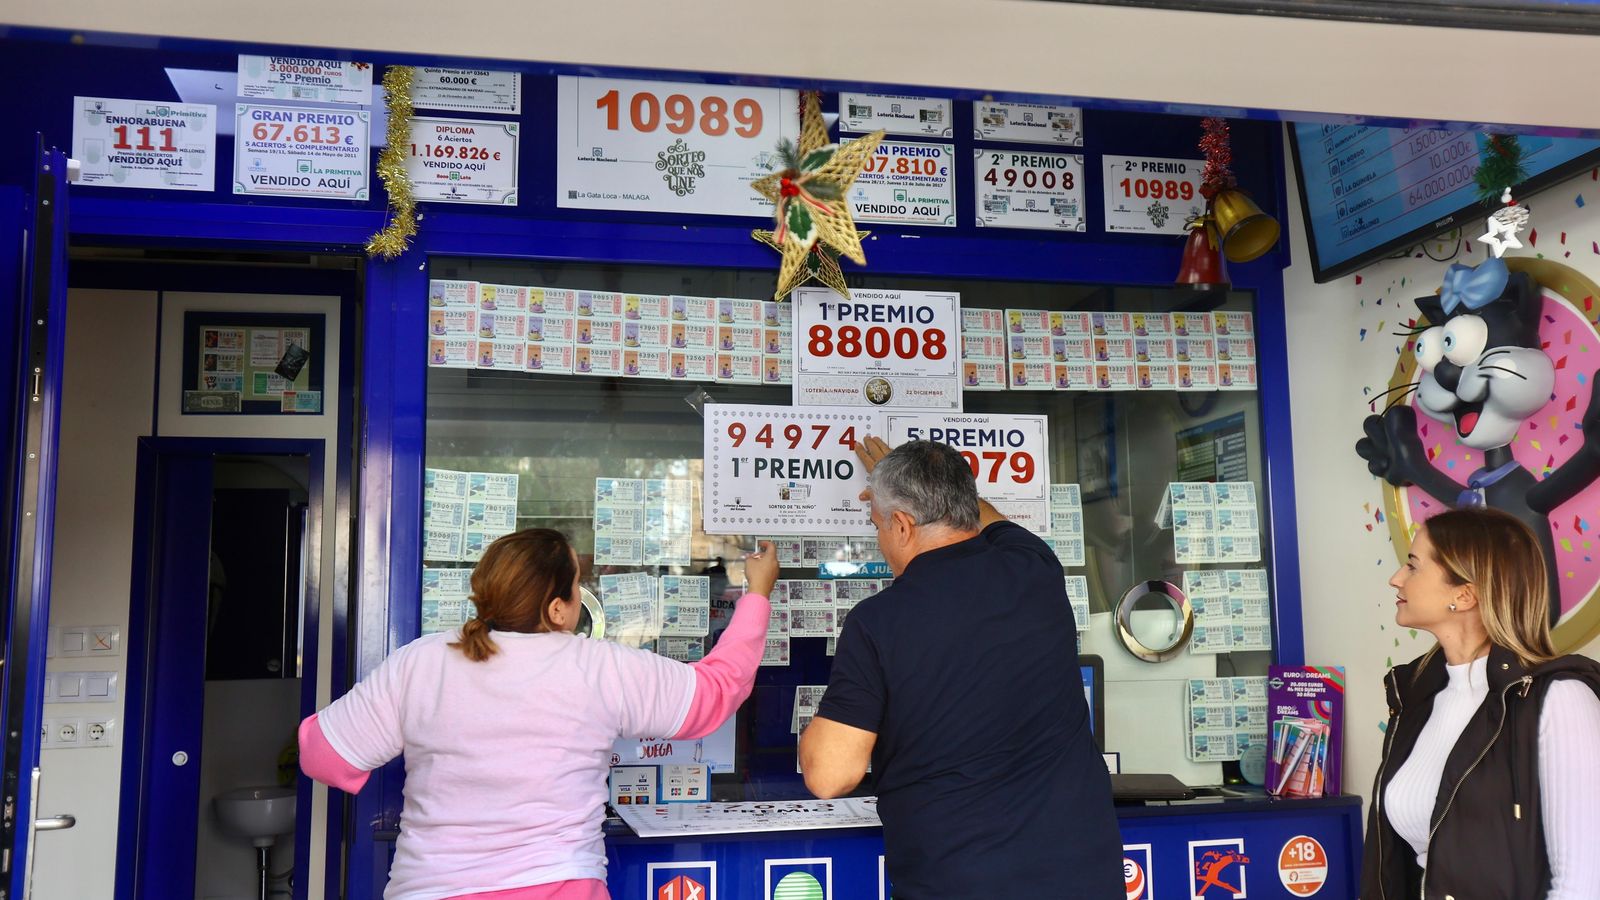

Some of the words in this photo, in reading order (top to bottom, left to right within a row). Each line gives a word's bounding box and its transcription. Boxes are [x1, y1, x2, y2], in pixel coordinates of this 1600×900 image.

[270, 64, 321, 75] 3.000.000
[295, 74, 331, 84] Premio
[440, 76, 469, 84] 60.000
[171, 110, 207, 118] Primitiva
[252, 110, 292, 122] GRAN
[298, 113, 354, 125] PREMIO
[596, 90, 763, 139] 10989
[106, 116, 186, 128] ENHORABUENA
[253, 123, 340, 144] 67.613
[345, 136, 354, 145] €
[436, 126, 475, 135] DIPLOMA
[113, 125, 177, 151] 111
[444, 135, 472, 143] Aciertos
[295, 144, 359, 152] COMPLEMENTARIO
[411, 144, 489, 160] 1.169.826
[493, 152, 501, 160] €
[892, 146, 940, 157] PREMIO
[108, 155, 154, 165] VENDIDO
[156, 157, 183, 168] AQUÍ
[423, 161, 462, 169] VENDIDO
[464, 162, 486, 171] AQUÍ
[655, 150, 705, 171] SORTEO
[863, 156, 937, 175] 07.810
[940, 167, 948, 176] €
[991, 154, 1004, 165] 2º
[1012, 155, 1067, 169] PREMIO
[668, 166, 685, 177] QUE
[1142, 161, 1186, 174] PREMIO
[251, 175, 311, 187] VENDIDO
[318, 177, 350, 189] AQUÍ
[984, 168, 1074, 190] 49008
[1120, 178, 1194, 201] 10989
[856, 204, 906, 214] VENDIDO
[912, 205, 940, 216] AQUÍ
[1435, 216, 1454, 228] PHILIPS
[854, 292, 883, 300] VENDIDO
[885, 292, 901, 300] AQUÍ
[837, 303, 934, 324] PREMIO
[808, 324, 947, 360] 88008
[727, 422, 856, 450] 94974
[929, 428, 1025, 448] PREMIO
[754, 458, 854, 480] PREMIO
[872, 566, 893, 574] JUE
[712, 600, 735, 609] LOCA
[640, 743, 673, 759] JUEGA
[1289, 841, 1316, 862] +18
